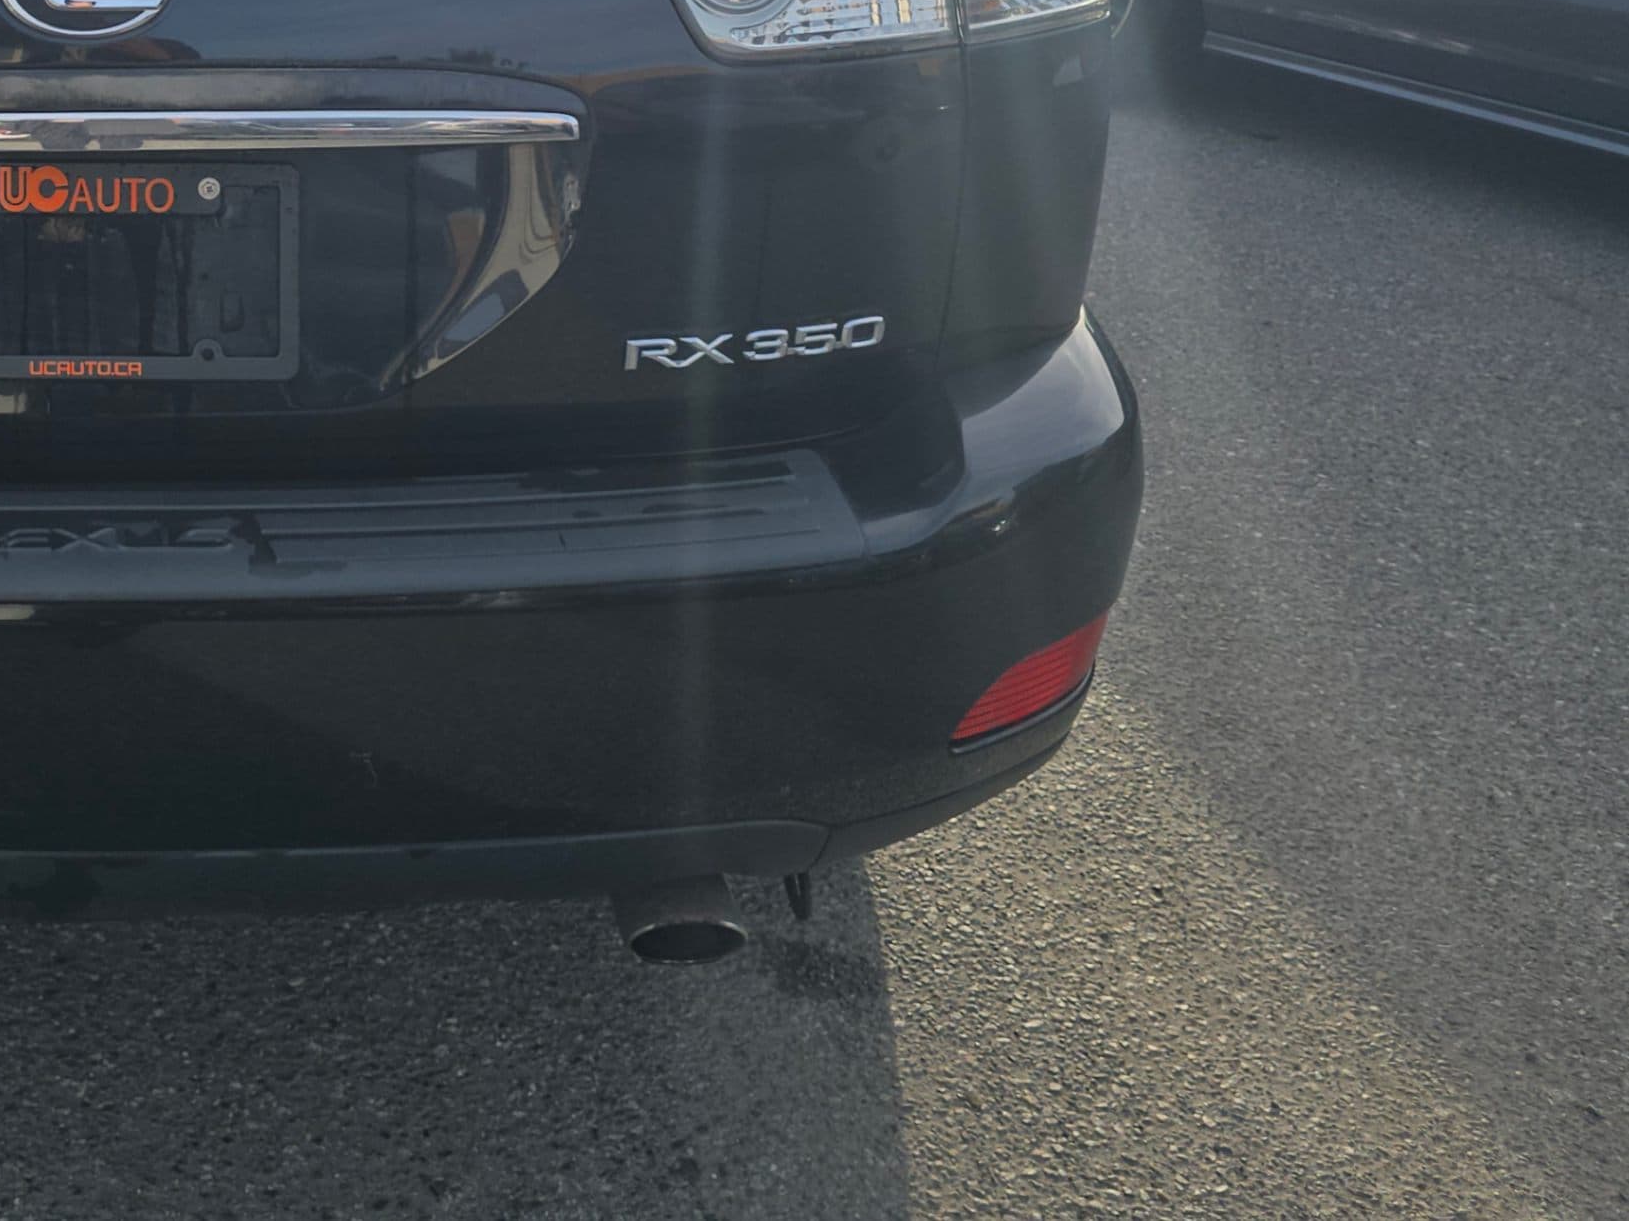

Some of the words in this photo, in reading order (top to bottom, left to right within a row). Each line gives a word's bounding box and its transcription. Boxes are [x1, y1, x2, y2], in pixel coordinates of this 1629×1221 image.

[624, 333, 735, 371] RX
[743, 316, 885, 361] 350
[29, 361, 143, 376] UCAUTO.CA
